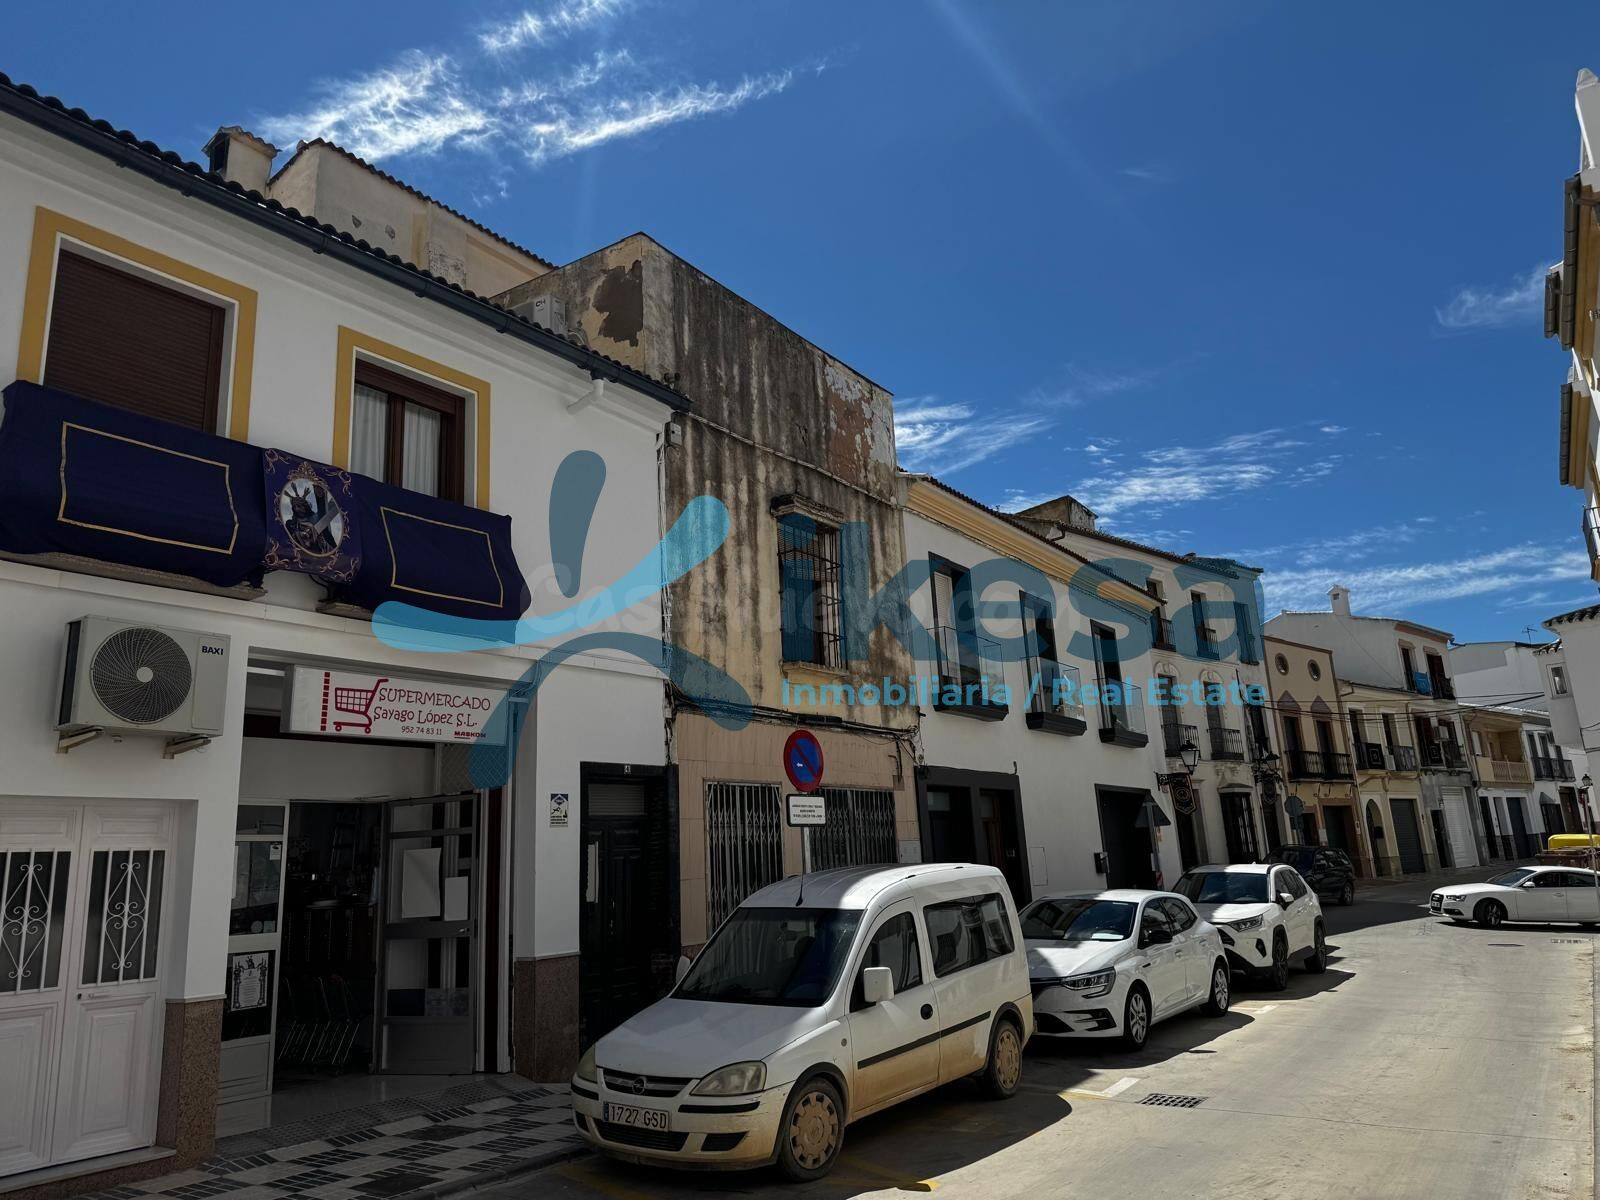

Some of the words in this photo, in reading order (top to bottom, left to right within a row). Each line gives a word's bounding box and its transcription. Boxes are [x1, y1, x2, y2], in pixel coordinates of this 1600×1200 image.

[202, 645, 224, 655] BAXI
[379, 688, 491, 711] SUPERMERCADO
[373, 706, 415, 723] Sayago
[418, 709, 453, 725] López
[457, 713, 478, 727] S.L.
[401, 726, 414, 734] 952
[416, 727, 425, 735] 74
[426, 727, 435, 736] 83
[436, 728, 442, 736] 11
[612, 1106, 639, 1125] 1727
[644, 1111, 667, 1129] GSD
